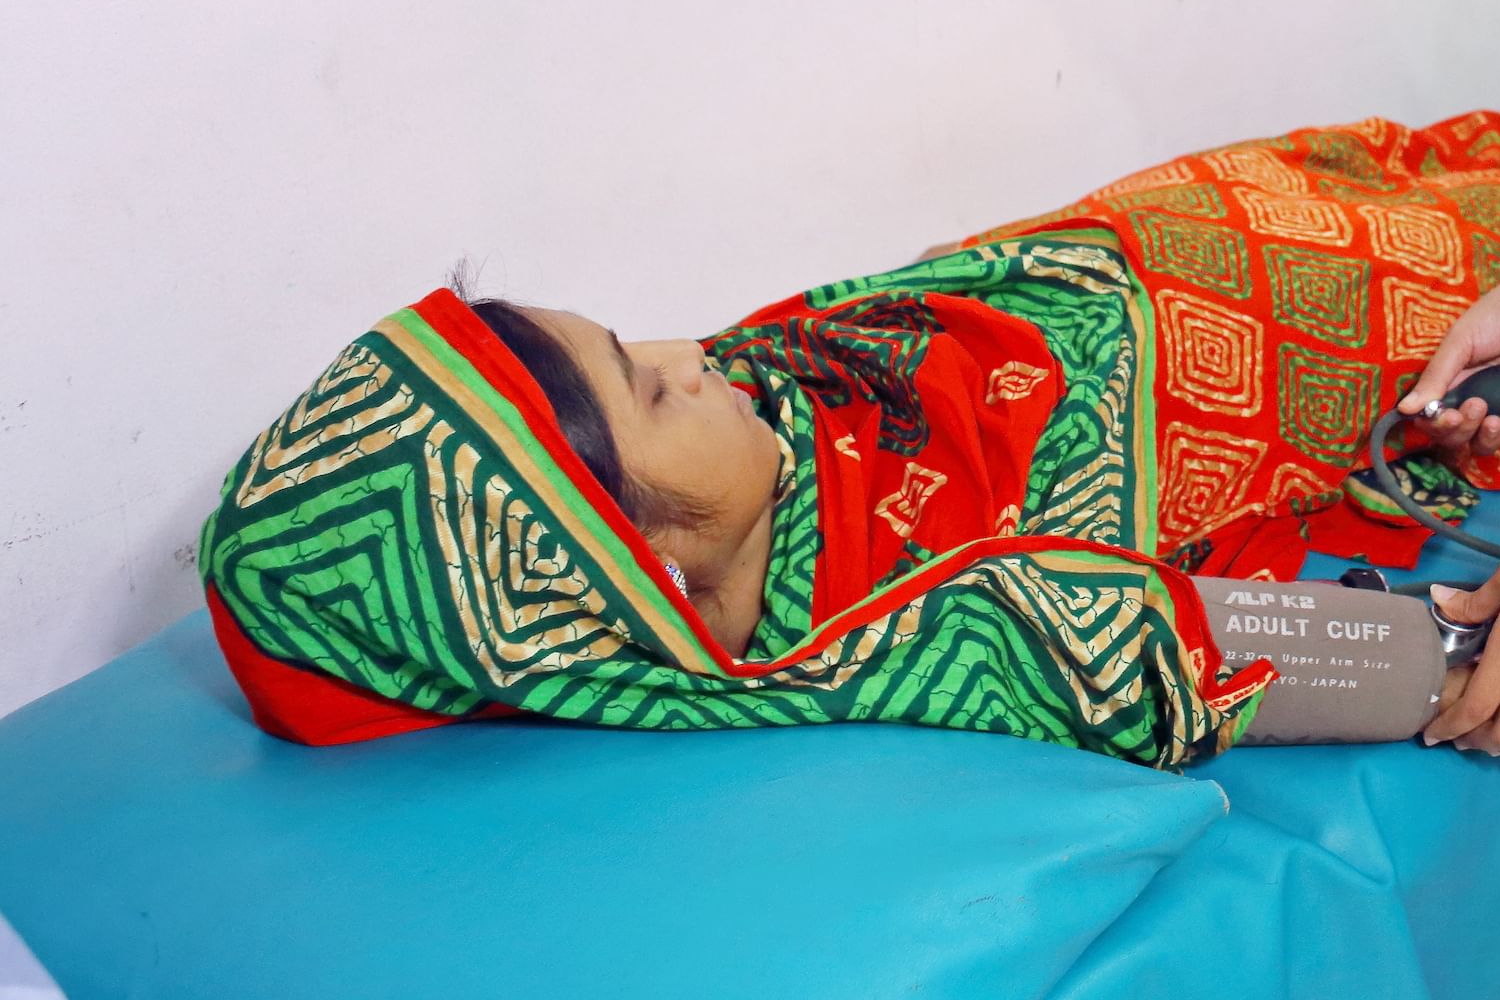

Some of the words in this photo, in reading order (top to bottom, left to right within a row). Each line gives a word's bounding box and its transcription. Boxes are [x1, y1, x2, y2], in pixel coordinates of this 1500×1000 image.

[1226, 614, 1310, 637] ADULT
[1327, 620, 1391, 642] CUFF
[1282, 653, 1320, 666] Upper
[1330, 656, 1353, 667] Arm
[1363, 659, 1390, 670] Size
[1310, 677, 1358, 689] JAPAN
